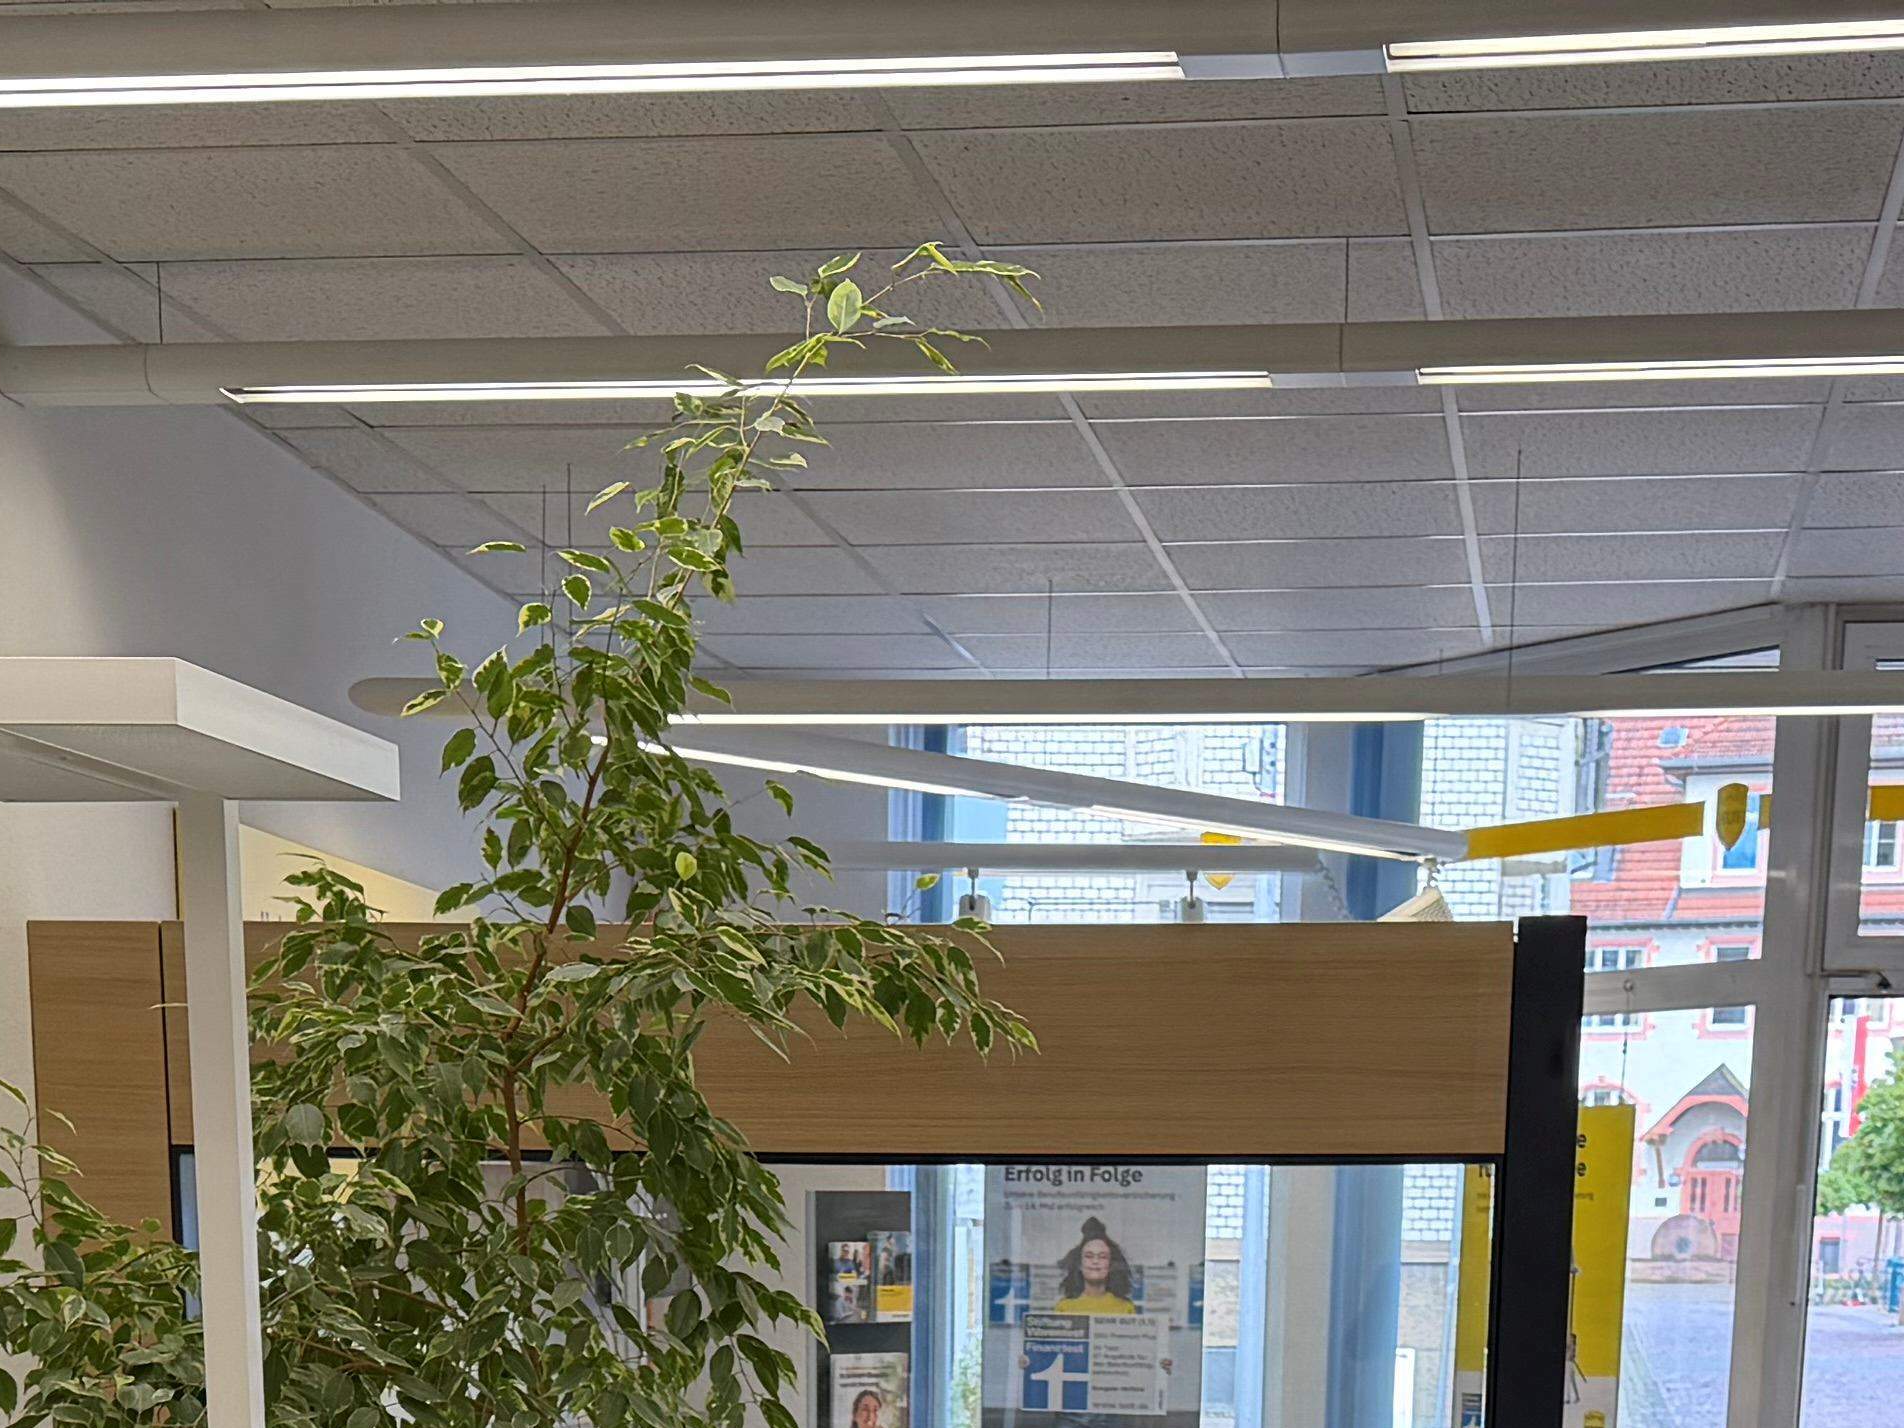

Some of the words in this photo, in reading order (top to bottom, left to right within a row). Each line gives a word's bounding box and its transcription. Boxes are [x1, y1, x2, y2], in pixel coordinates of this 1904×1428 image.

[1004, 1166, 1064, 1187] Erfolg
[1068, 1166, 1085, 1183] in
[1090, 1166, 1144, 1188] Folge
